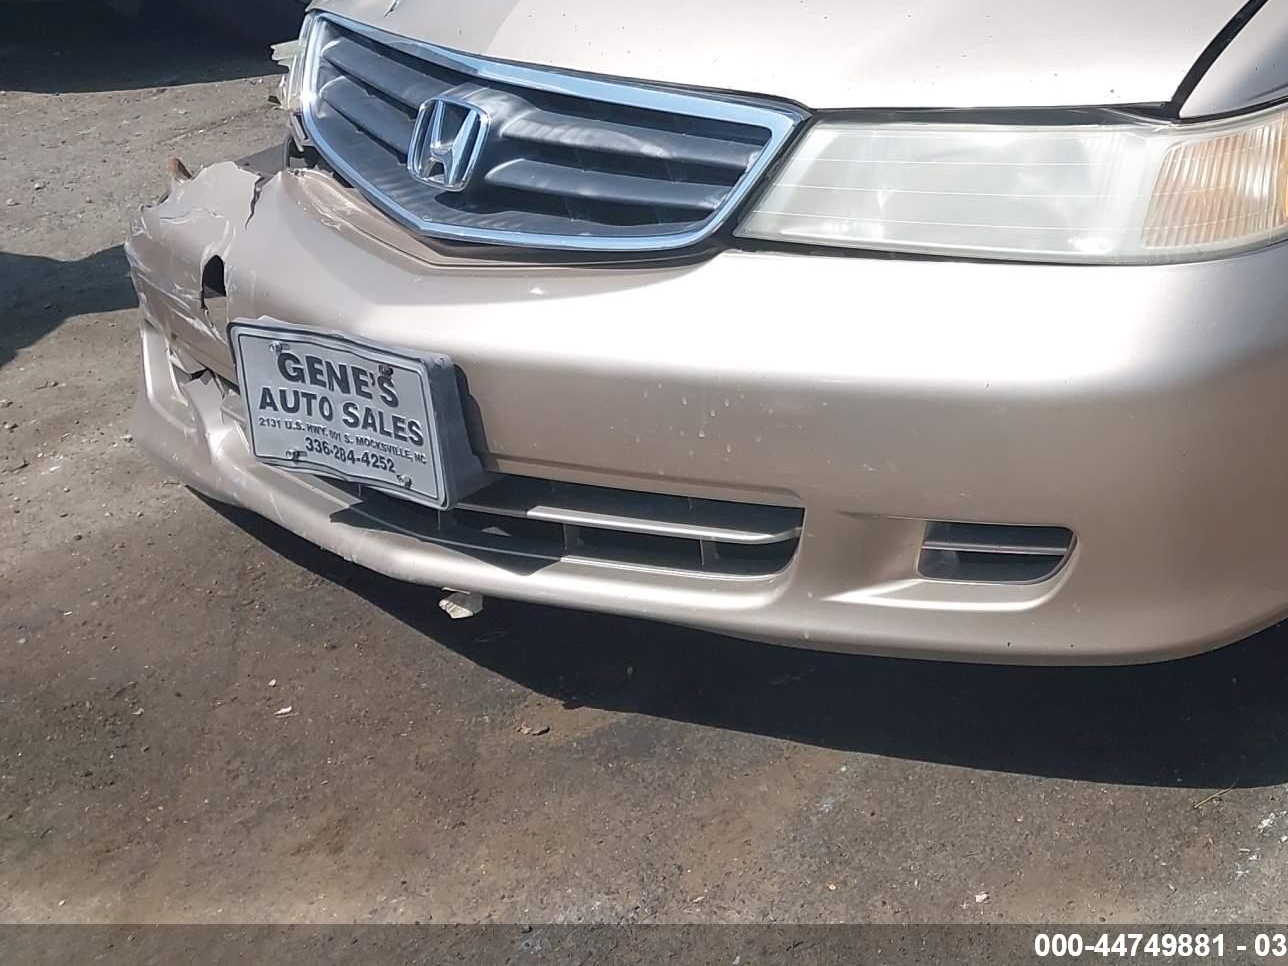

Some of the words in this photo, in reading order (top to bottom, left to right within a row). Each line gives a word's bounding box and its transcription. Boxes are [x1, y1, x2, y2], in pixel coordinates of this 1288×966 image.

[277, 352, 400, 408] GENE'S
[258, 387, 333, 422] AUTO
[341, 402, 425, 447] SALES
[258, 417, 281, 429] 2131
[284, 420, 305, 431] U.S.
[414, 452, 428, 465] NC
